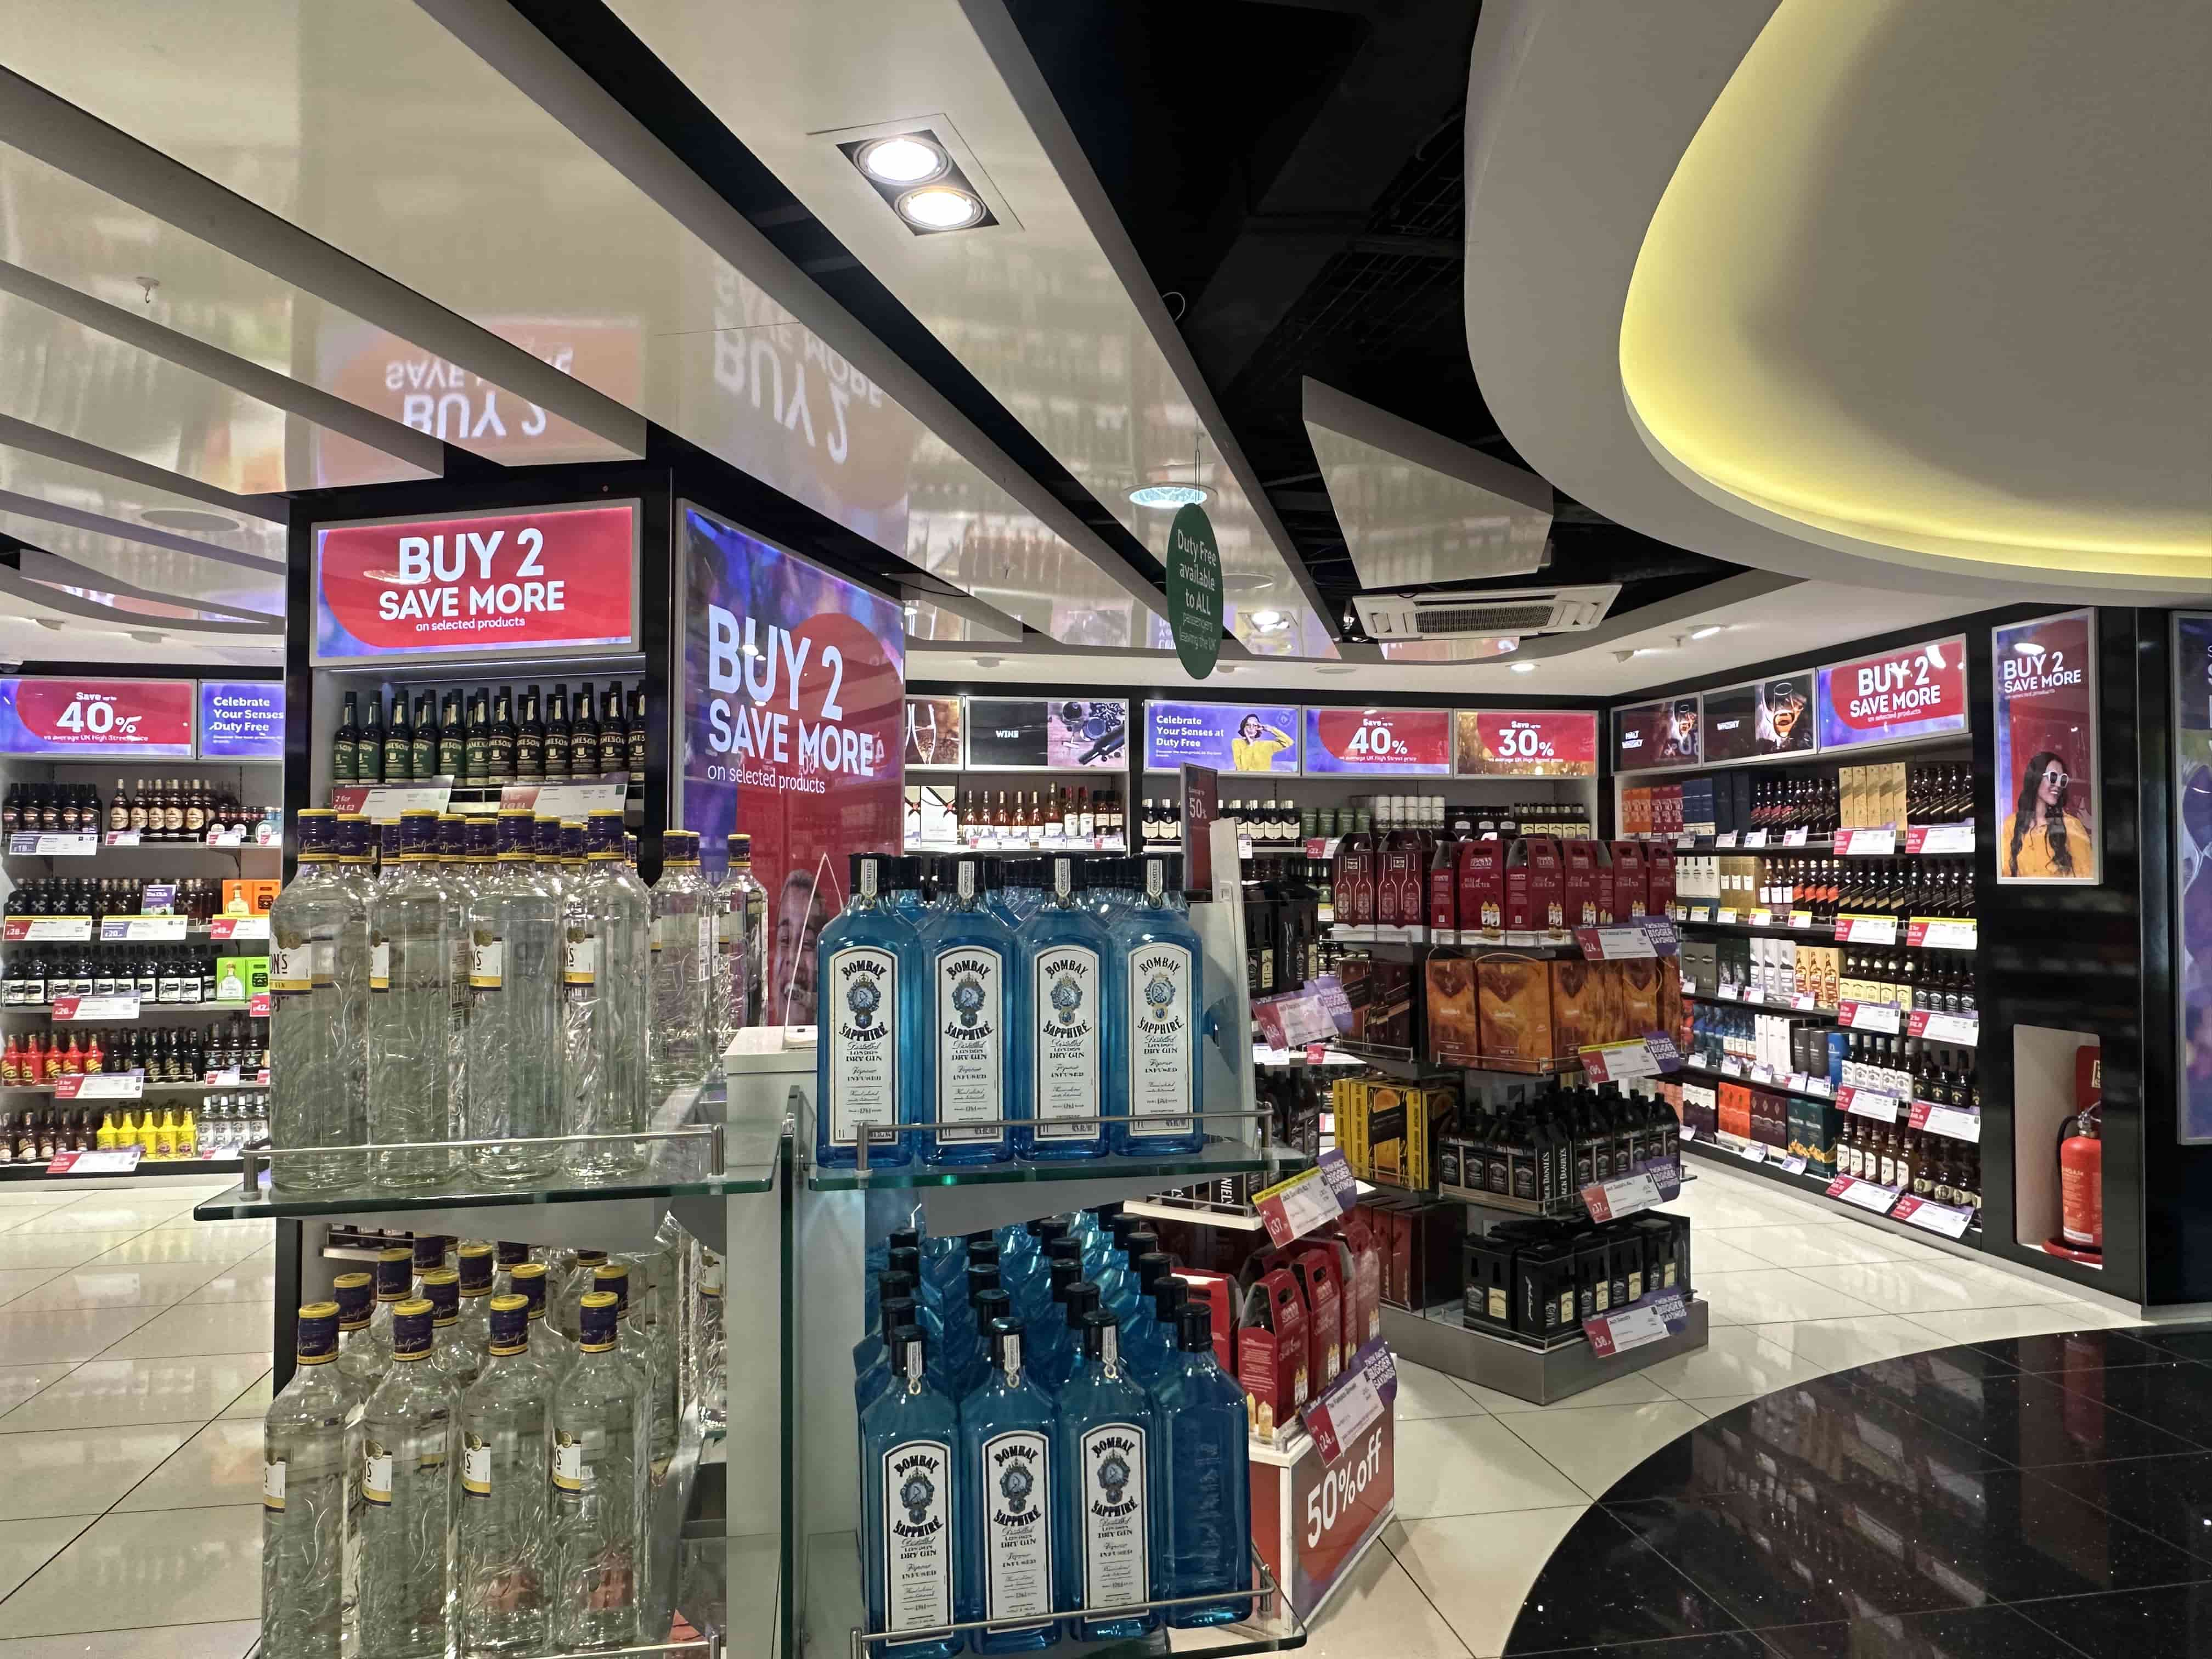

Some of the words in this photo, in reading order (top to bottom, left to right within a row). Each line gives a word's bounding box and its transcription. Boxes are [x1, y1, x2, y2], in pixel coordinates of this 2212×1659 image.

[398, 530, 505, 583] BUY
[517, 528, 545, 577] 2
[1177, 529, 1198, 562] Duty
[1200, 540, 1216, 566] Free
[1180, 563, 1215, 591] available
[379, 587, 459, 621] SAVE
[469, 580, 565, 616] MORE
[1186, 588, 1195, 608] to
[1196, 591, 1211, 616] ALL
[415, 622, 429, 632] on
[431, 618, 476, 631] selected
[477, 617, 526, 631] products
[708, 604, 812, 711] BUY
[821, 645, 843, 721] 2
[2004, 653, 2047, 680] BUY
[2052, 651, 2064, 673] 2
[1858, 659, 1909, 696] BUY
[1914, 656, 1930, 686] 2
[2004, 676, 2038, 693] SAVE
[2041, 669, 2081, 689] MORE
[76, 692, 101, 701] Save
[213, 696, 270, 707] Celebrate
[1850, 695, 1889, 718] SAVE
[1893, 685, 1941, 711] MORE
[57, 702, 138, 733] 40%
[213, 709, 242, 719] Your
[245, 709, 284, 719] Senses
[1156, 715, 1202, 725] Celebrate
[213, 721, 242, 733] Duty
[245, 722, 269, 731] Free
[708, 698, 789, 764] SAVE
[798, 718, 874, 777] MORE
[995, 730, 1019, 738] WINE
[1156, 726, 1180, 736] Your
[1181, 727, 1213, 737] Senses
[1156, 738, 1179, 748] Duty
[1181, 738, 1201, 747] Free
[1348, 726, 1408, 755] 40%
[1498, 729, 1554, 757] 30%
[708, 765, 726, 782] on
[730, 769, 776, 788] selected
[778, 774, 826, 795] products
[841, 960, 888, 981] BOMBAY
[946, 960, 991, 981] BOMBAY
[1045, 959, 1089, 979] BOMBAY
[1138, 956, 1181, 976] BOMBAY
[839, 1022, 891, 1041] SAPPHIRE
[944, 1020, 995, 1041] SAPPHIRE
[1043, 1019, 1092, 1039] SAPPHIRE
[1137, 1015, 1184, 1035] SAPPHIRE
[994, 1445, 1039, 1467] BOMBAY
[1091, 1436, 1135, 1459] BOMBAY
[894, 1455, 940, 1477] BOMBAY
[992, 1504, 1042, 1527] SAPPHIRE
[1091, 1496, 1140, 1517] SAPPHIRE
[893, 1515, 944, 1537] SAPPHIRE
[1117, 1529, 1133, 1537] GIN
[1019, 1538, 1036, 1547] GIN
[920, 1549, 937, 1558] GIN
